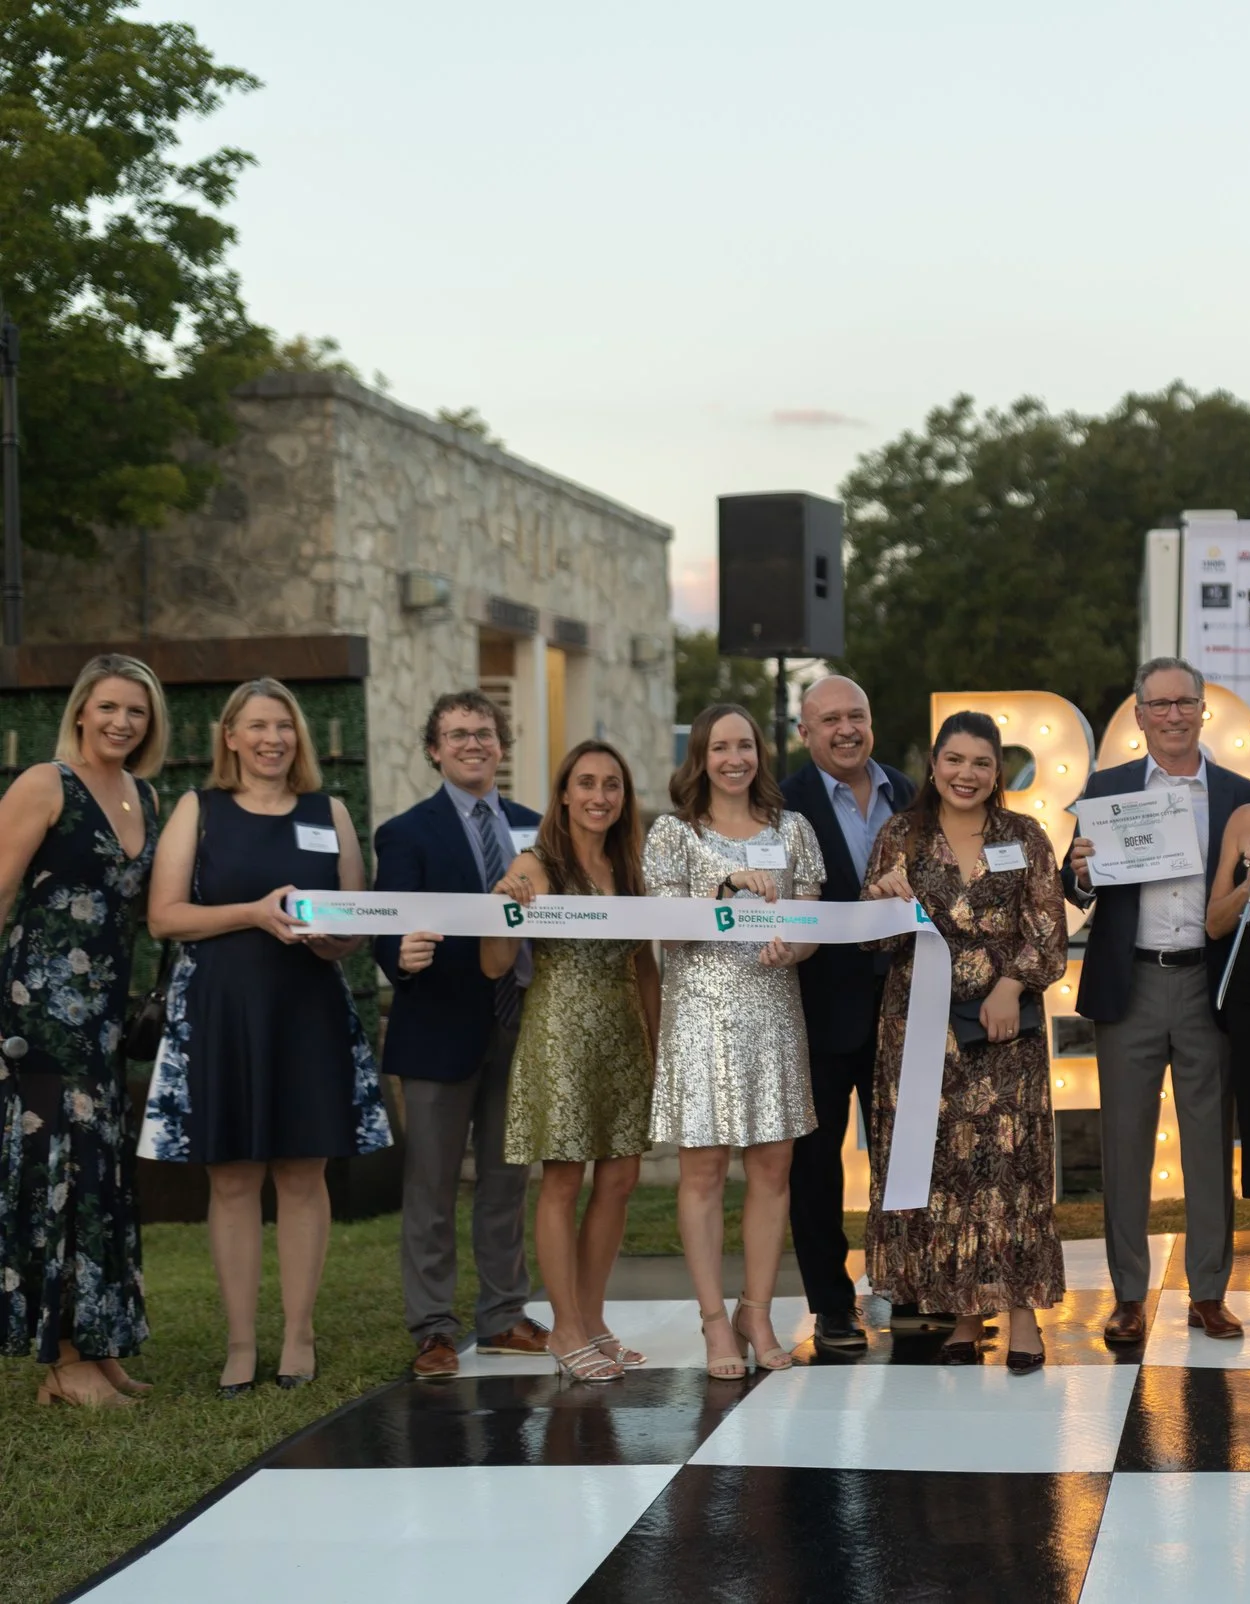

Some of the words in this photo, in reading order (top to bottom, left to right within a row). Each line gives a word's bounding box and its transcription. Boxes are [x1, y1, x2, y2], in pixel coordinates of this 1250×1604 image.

[1124, 834, 1154, 848] BOERNE
[356, 907, 399, 917] CHAMBER
[527, 911, 563, 919] BOERNE
[564, 912, 608, 920] CHAMBER
[738, 915, 774, 924] BOERNE
[775, 916, 818, 925] CHAMBER
